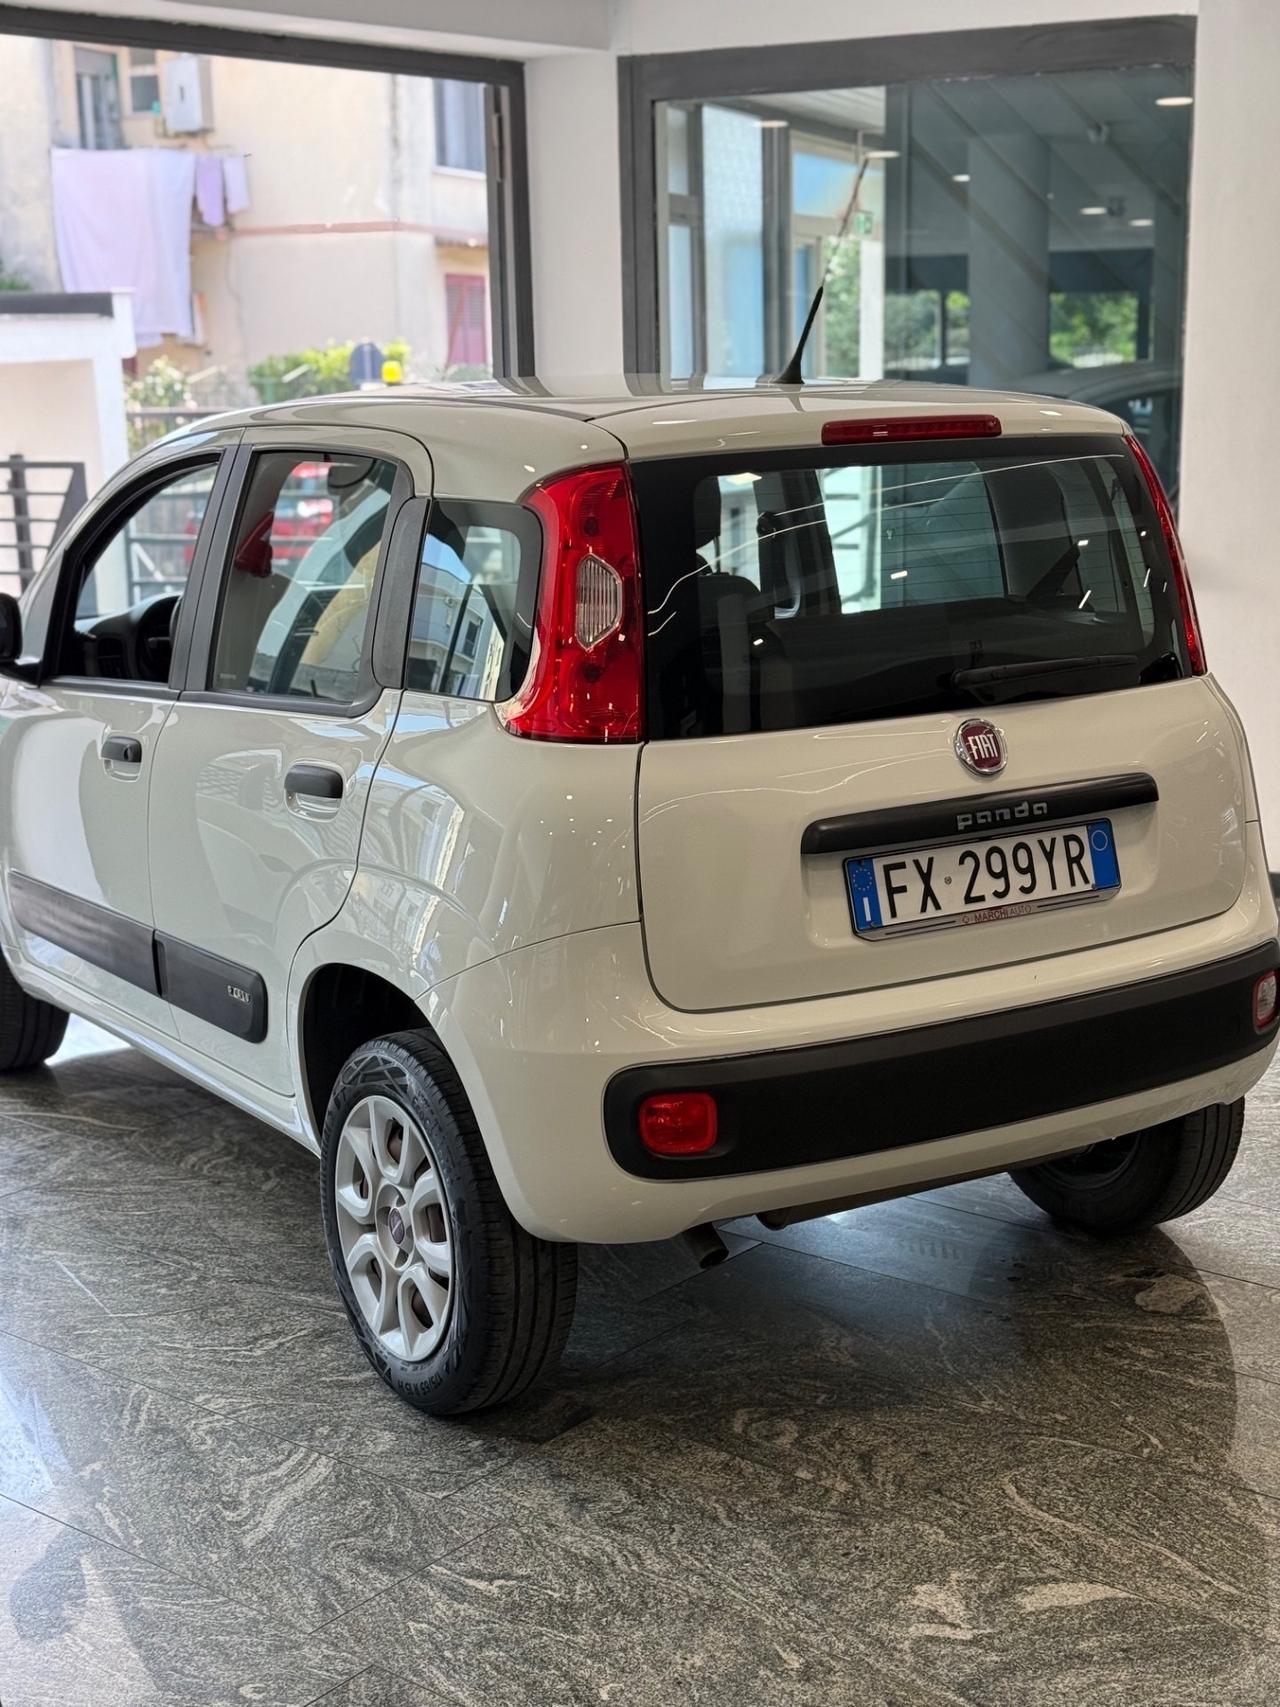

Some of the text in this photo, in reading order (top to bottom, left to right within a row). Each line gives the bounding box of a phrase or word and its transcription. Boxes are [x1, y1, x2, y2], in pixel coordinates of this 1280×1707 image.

[967, 733, 999, 760] FIAT
[956, 801, 1048, 831] panda
[882, 834, 1091, 919] FX 299YR
[974, 906, 1008, 923] MARCHI
